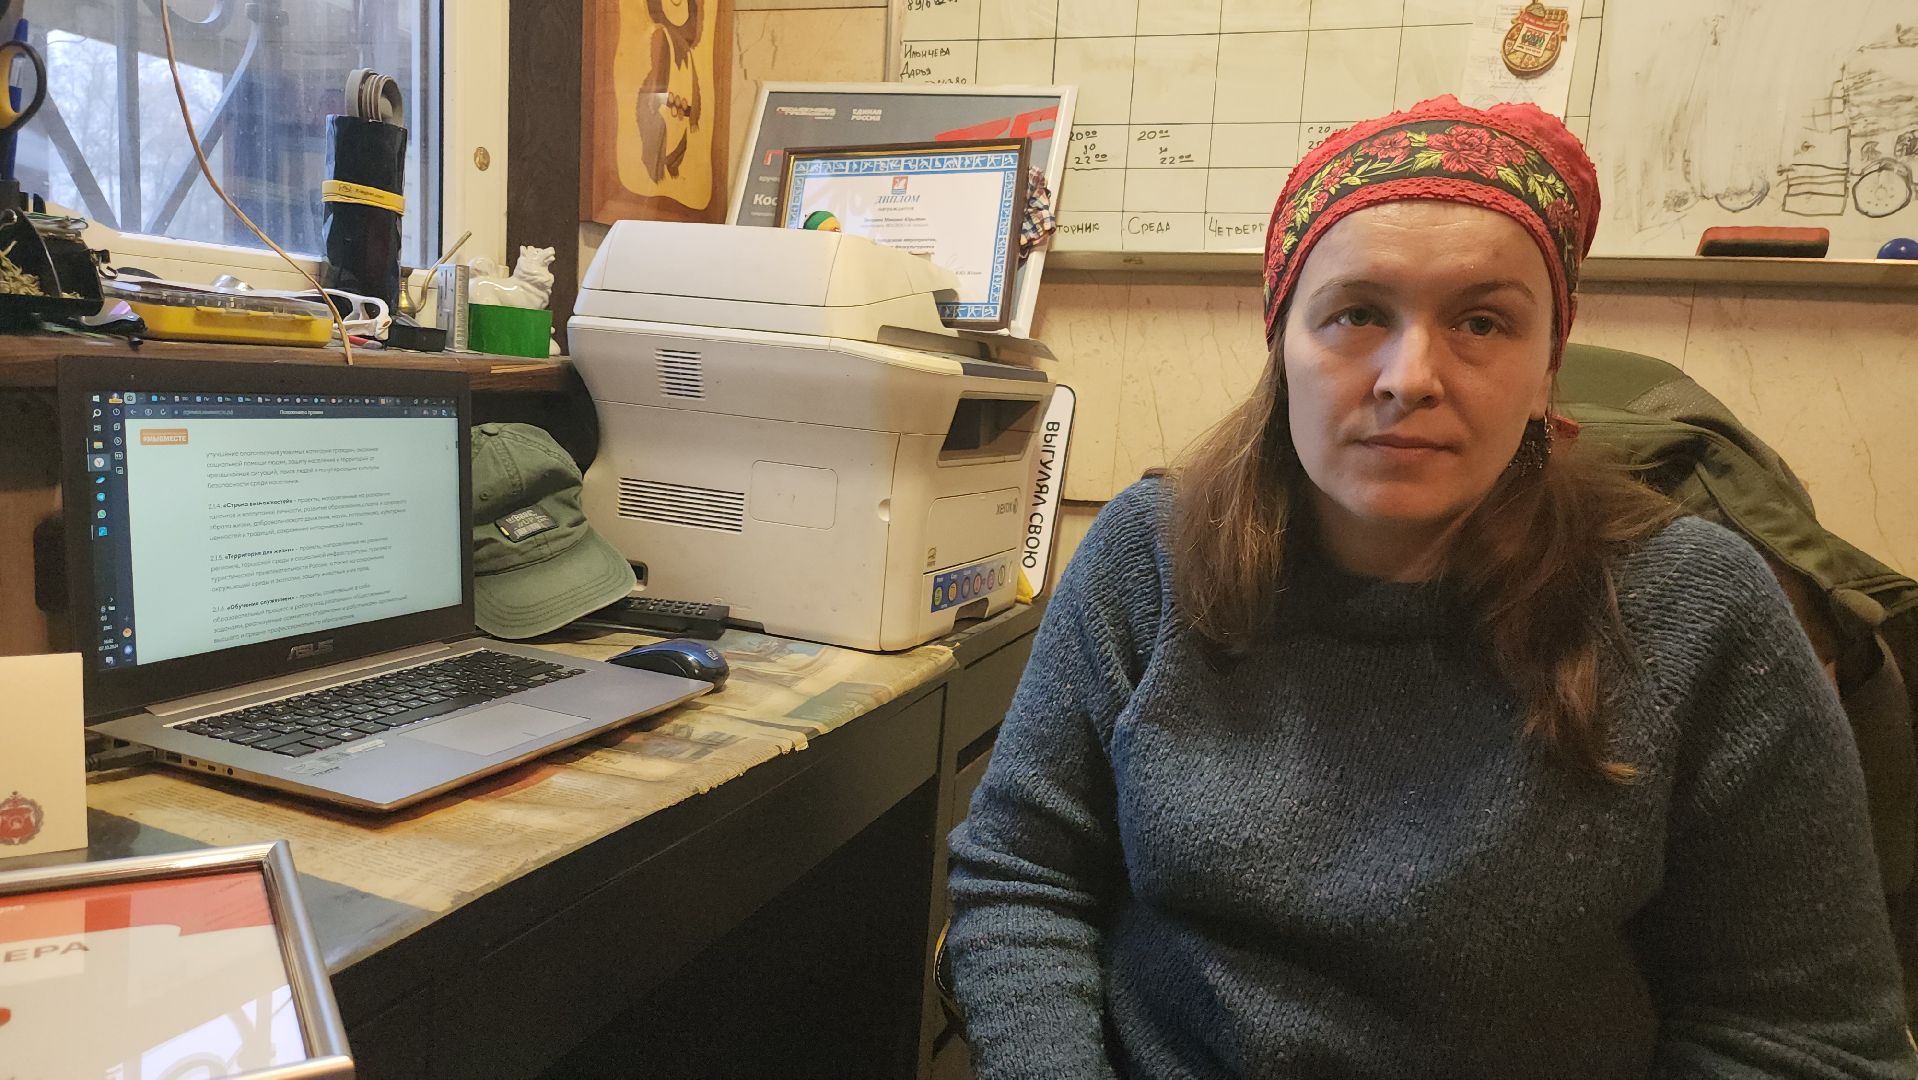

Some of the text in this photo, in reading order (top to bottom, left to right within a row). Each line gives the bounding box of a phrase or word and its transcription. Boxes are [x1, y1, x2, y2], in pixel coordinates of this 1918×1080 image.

[875, 195, 920, 204] ДИПЛОМ
[1022, 421, 1060, 569] ВЫГУЛЯЛ СВОЮ
[287, 640, 333, 661] ASUS
